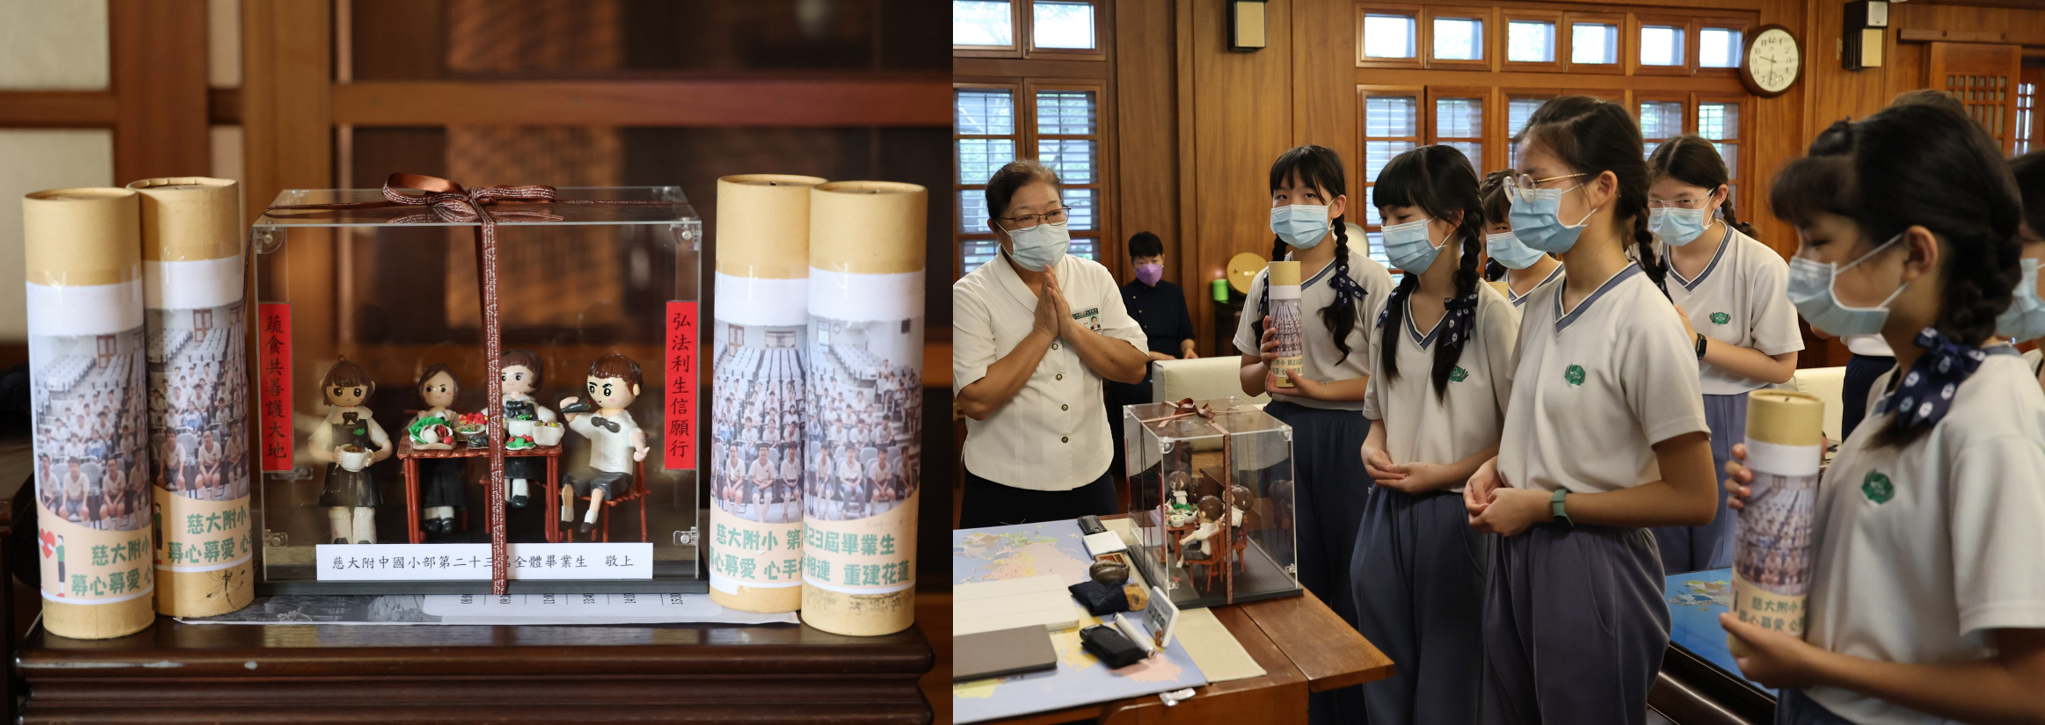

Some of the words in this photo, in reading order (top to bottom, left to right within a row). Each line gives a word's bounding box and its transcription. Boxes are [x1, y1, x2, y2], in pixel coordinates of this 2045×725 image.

[265, 314, 287, 459] 蔬食共善護大地
[669, 312, 691, 458] 弘法利生信願行
[186, 505, 247, 535] 慈大附小
[91, 535, 150, 567] 慈大附小
[167, 536, 235, 564] 募心募愛
[716, 523, 779, 551] 慈大附小
[605, 555, 634, 567] 敬上
[843, 559, 910, 586] 重建花蓮
[71, 568, 140, 597] 募心募愛
